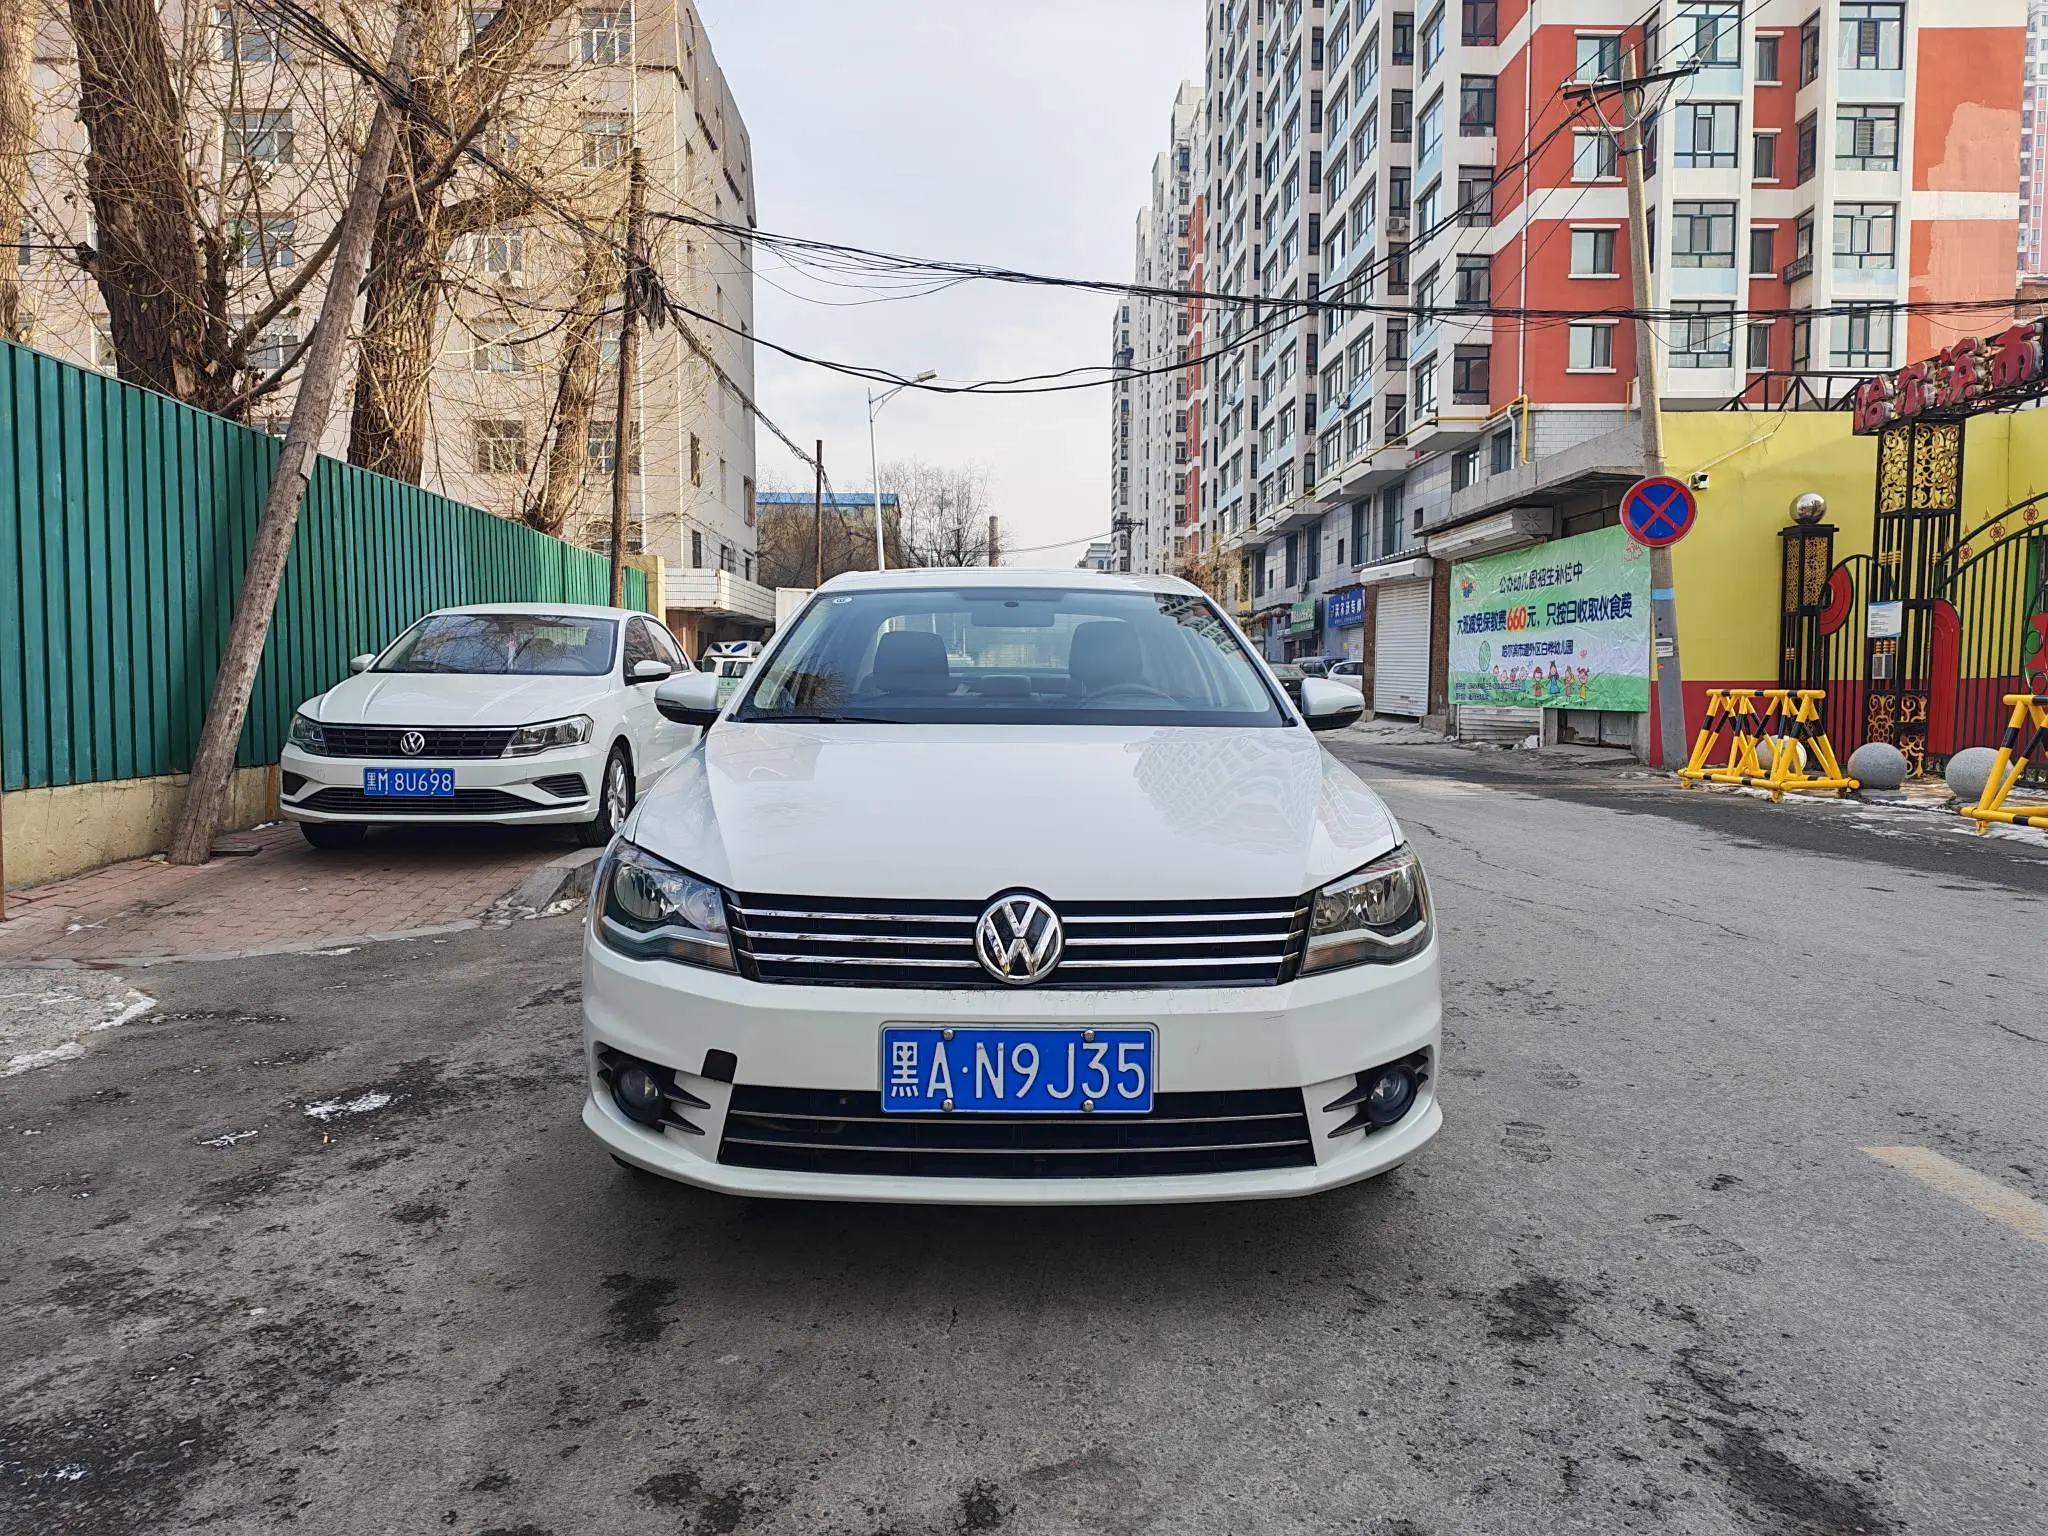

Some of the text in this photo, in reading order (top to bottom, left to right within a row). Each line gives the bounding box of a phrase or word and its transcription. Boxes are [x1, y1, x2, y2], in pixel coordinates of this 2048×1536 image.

[1854, 323, 2043, 432] 哈尔滨市
[1499, 560, 1583, 594] 公办幼儿园招生补位中
[1501, 639, 1574, 658] 哈尔滨市道外区白桦幼儿园
